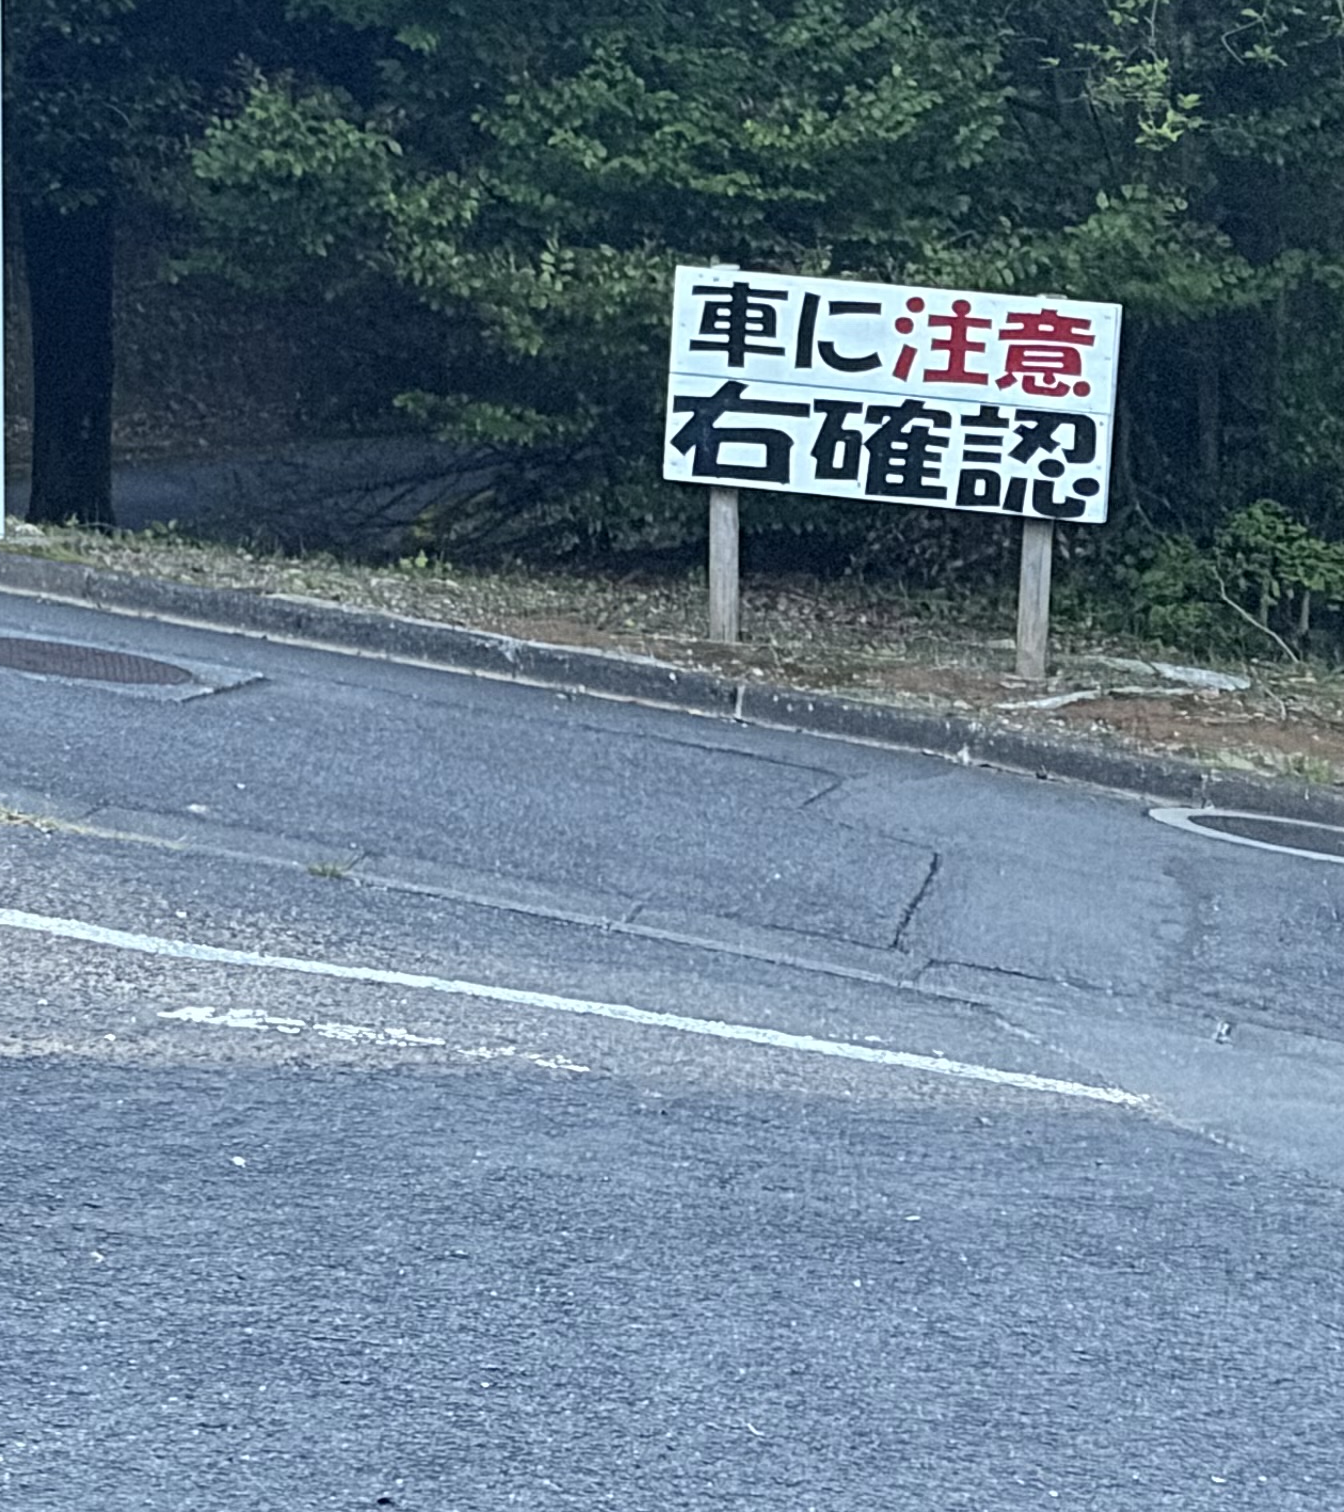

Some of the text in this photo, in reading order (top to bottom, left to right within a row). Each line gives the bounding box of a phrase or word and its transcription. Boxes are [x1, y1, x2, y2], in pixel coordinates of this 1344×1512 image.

[689, 282, 1096, 397] 車に注意
[670, 380, 1101, 519] 右確認
